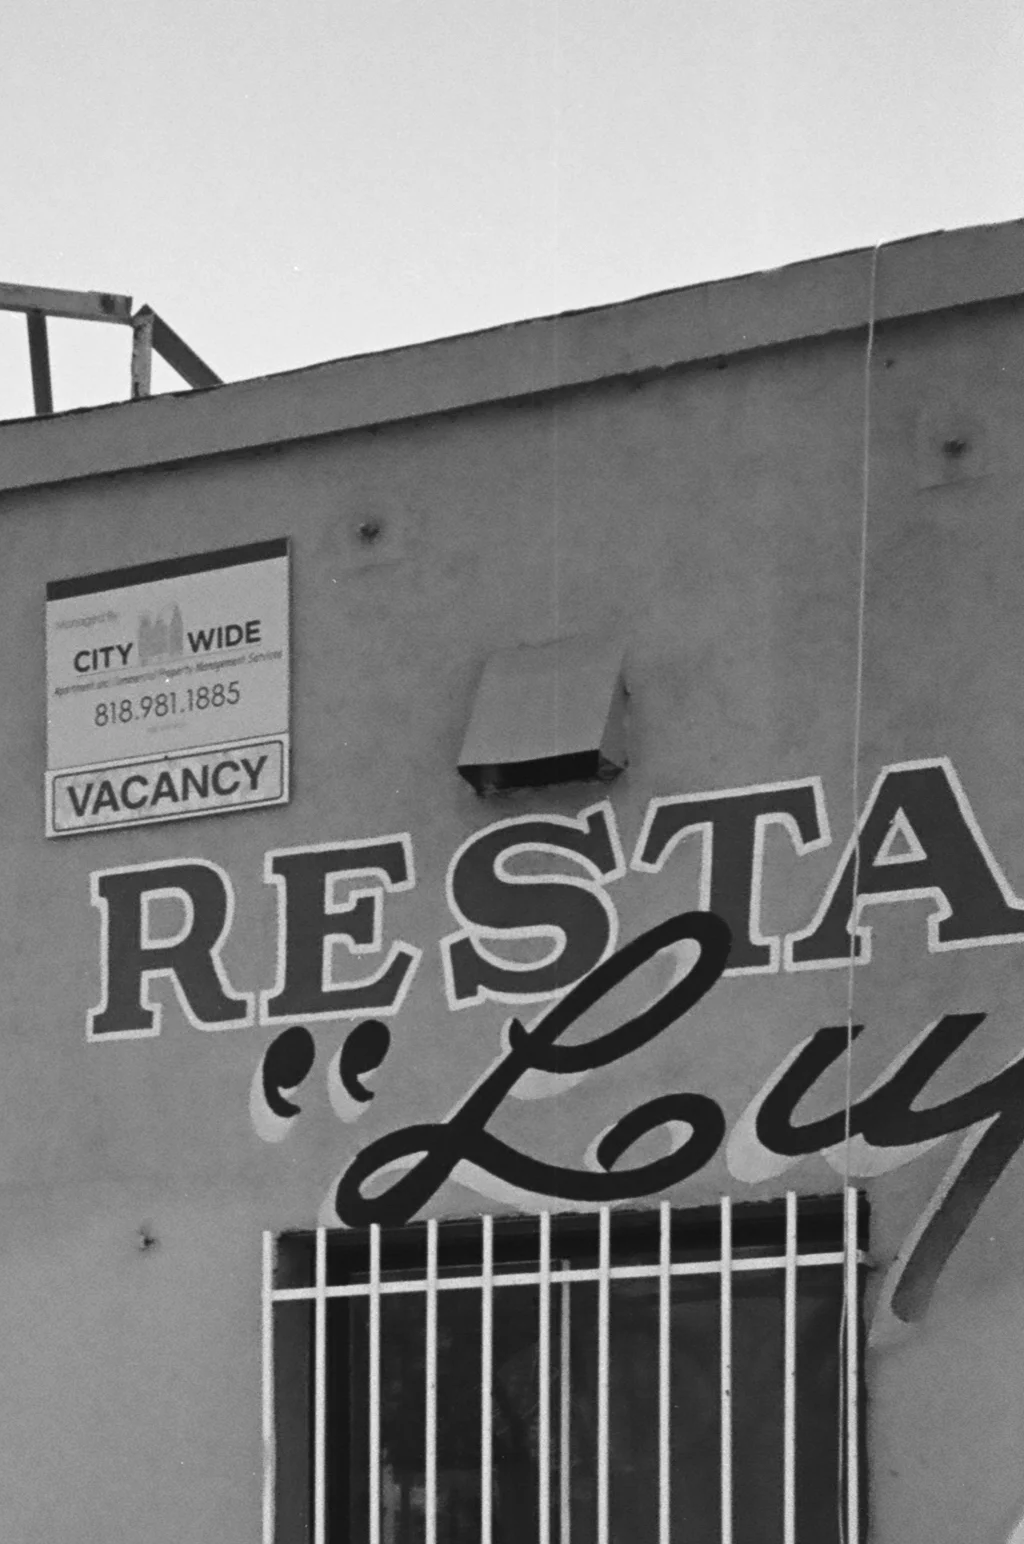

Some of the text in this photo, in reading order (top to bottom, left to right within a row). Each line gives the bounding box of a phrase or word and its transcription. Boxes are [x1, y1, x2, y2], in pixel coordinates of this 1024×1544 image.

[73, 619, 262, 673] CITY WIDE
[94, 680, 241, 727] 818.981.1885
[67, 755, 268, 817] VACANCY
